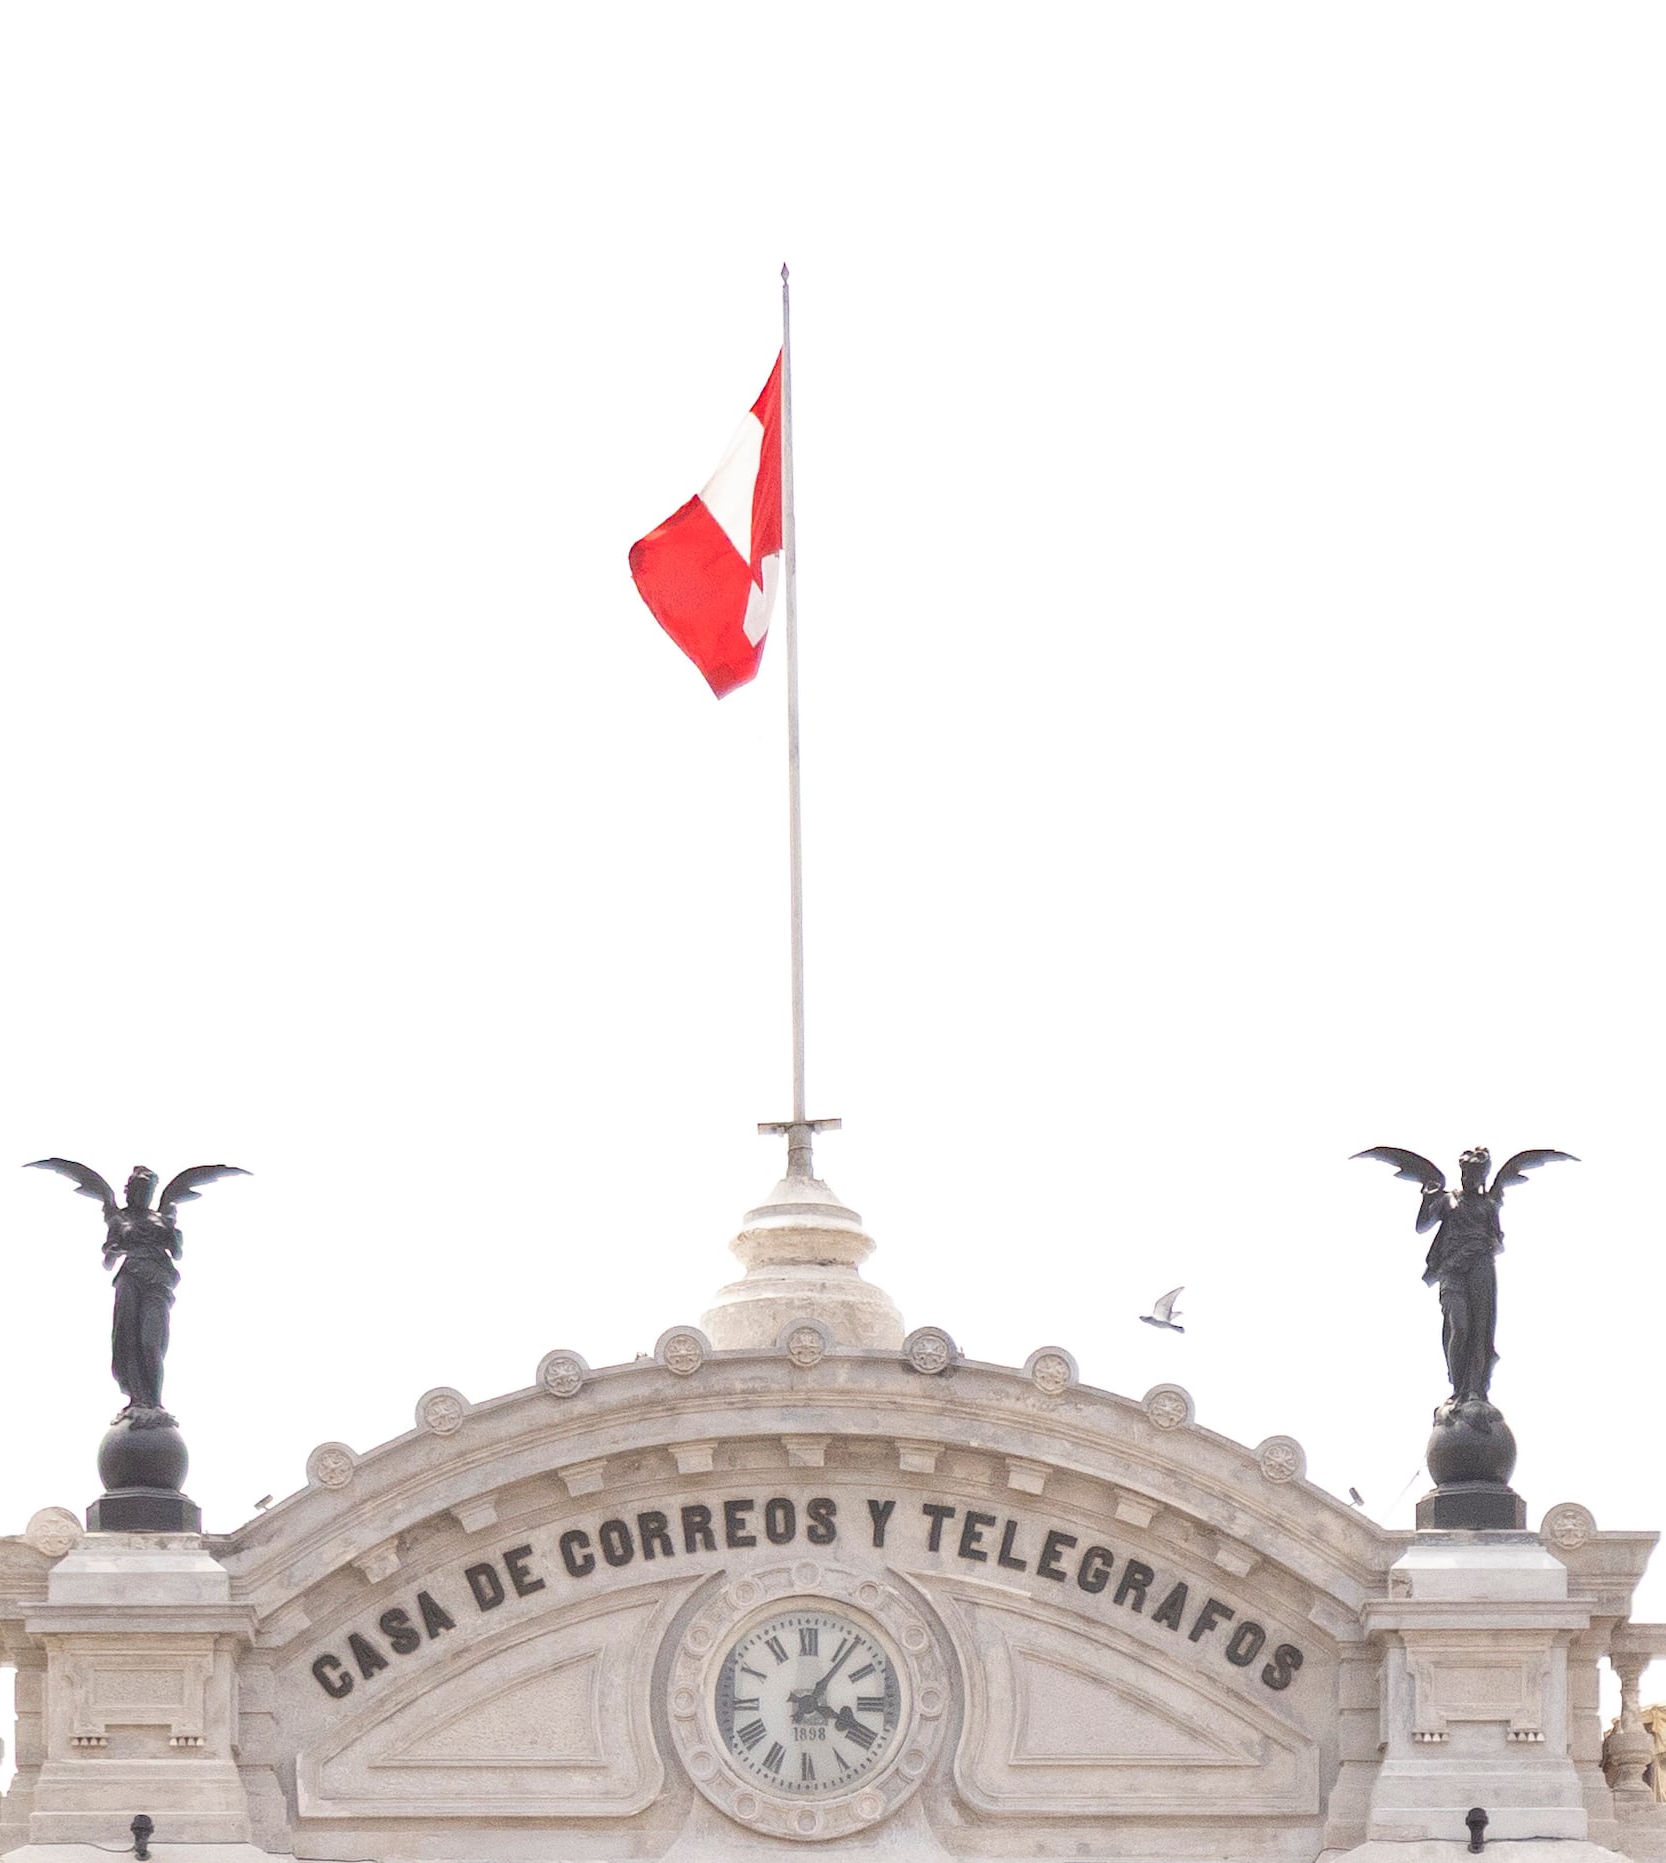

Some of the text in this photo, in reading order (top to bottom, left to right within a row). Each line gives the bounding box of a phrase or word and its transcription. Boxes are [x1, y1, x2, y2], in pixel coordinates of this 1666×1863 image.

[311, 1497, 1305, 1699] CASA DE CORREOS Y TELEGRAFOS
[792, 1727, 826, 1741] 1898
